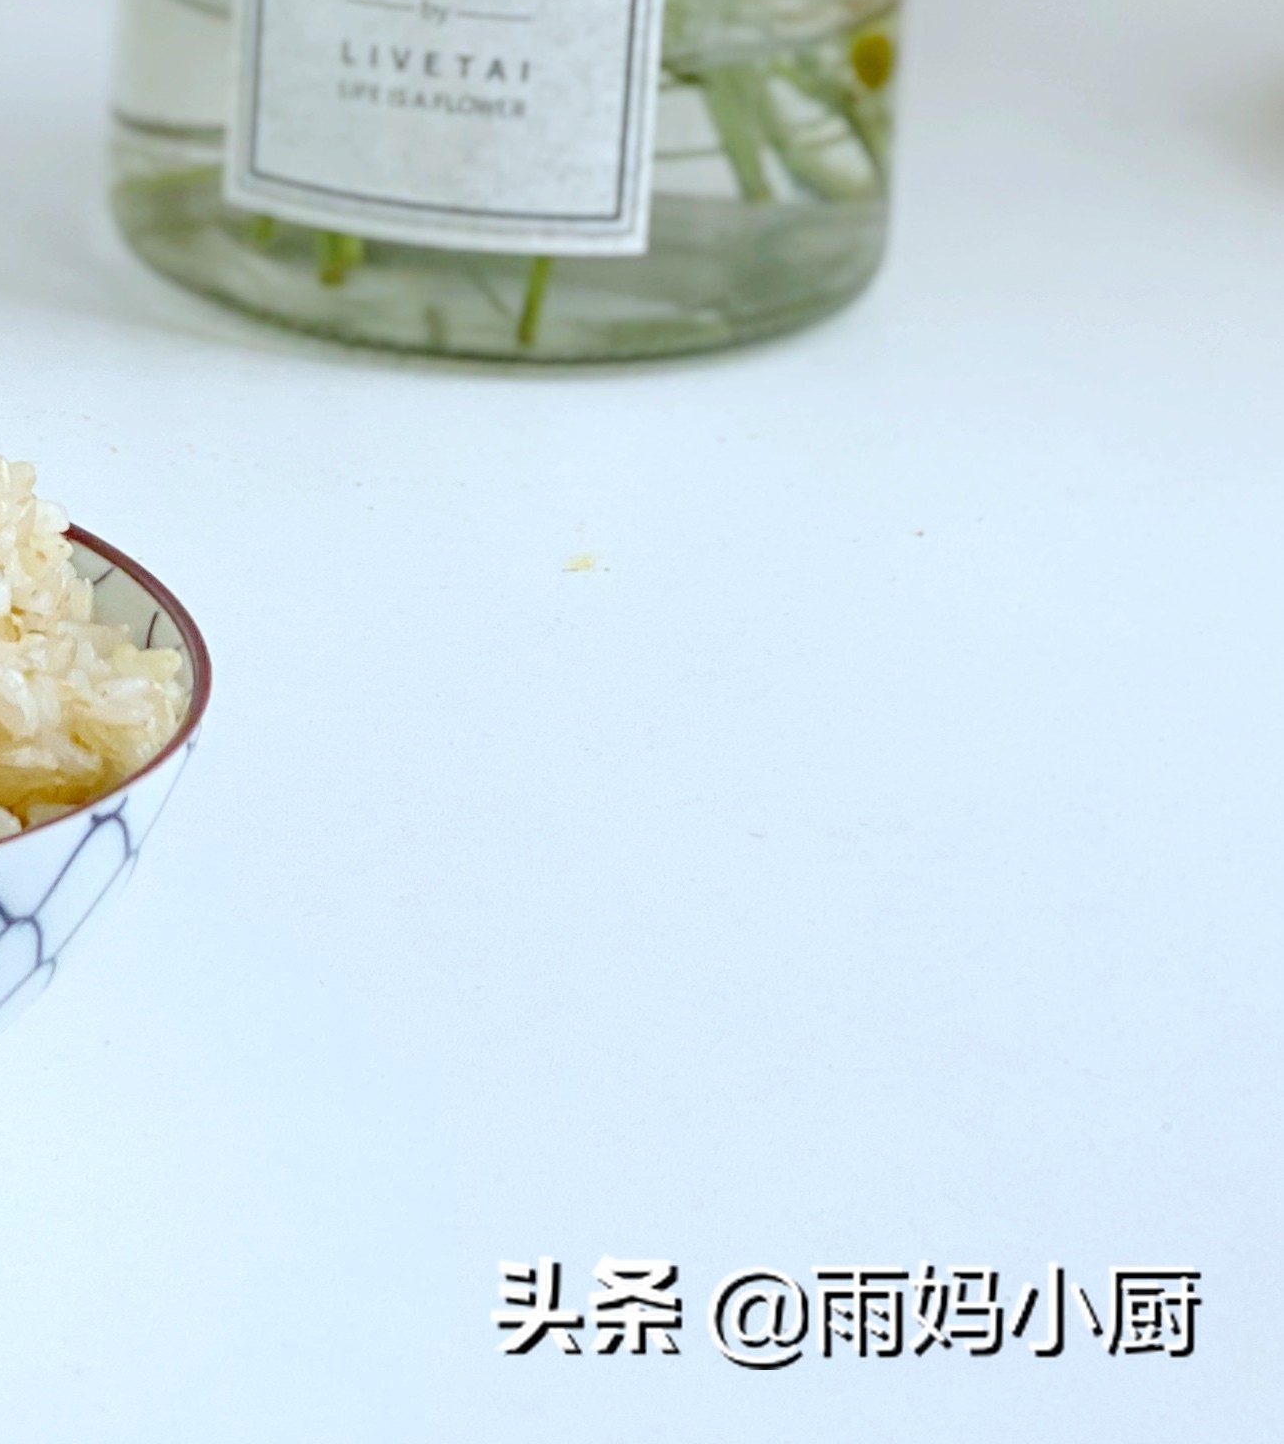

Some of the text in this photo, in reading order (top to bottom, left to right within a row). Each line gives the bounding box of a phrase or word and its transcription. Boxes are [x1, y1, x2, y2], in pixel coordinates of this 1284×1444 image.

[340, 40, 531, 83] LIVETAI
[413, 92, 427, 108] A
[433, 93, 527, 119] FLOWER
